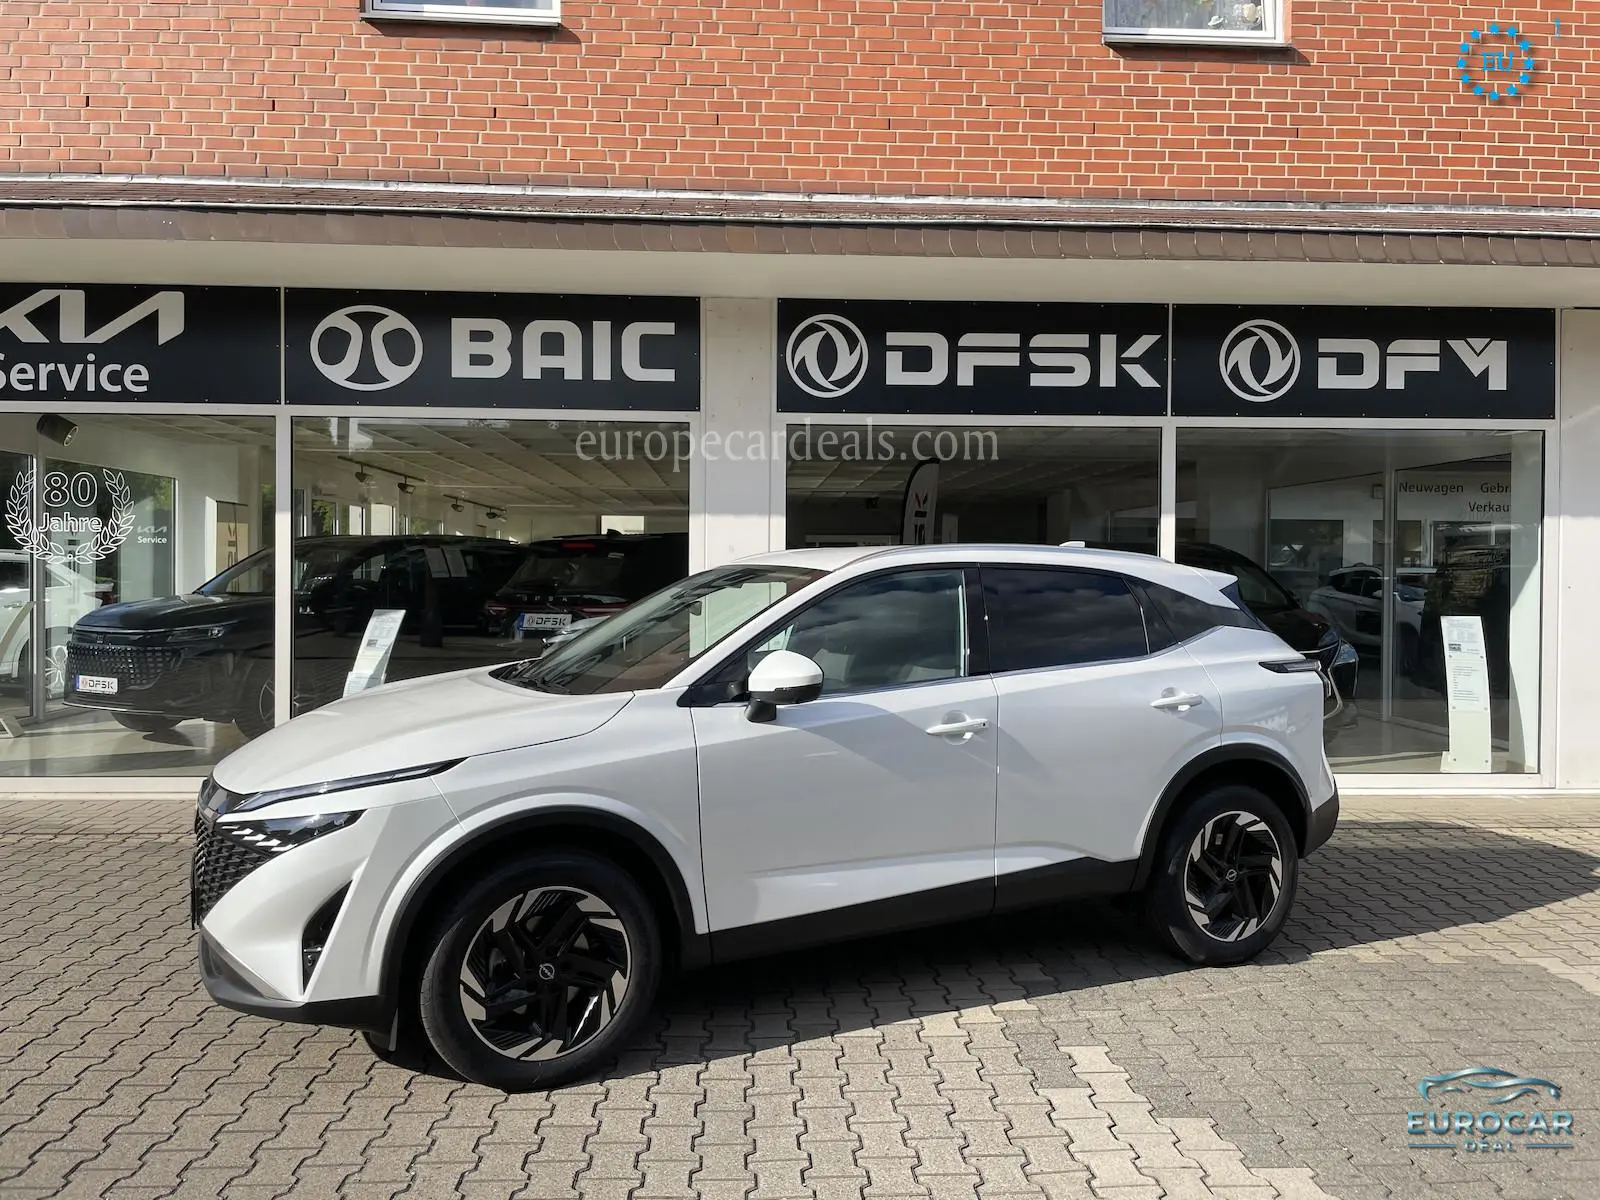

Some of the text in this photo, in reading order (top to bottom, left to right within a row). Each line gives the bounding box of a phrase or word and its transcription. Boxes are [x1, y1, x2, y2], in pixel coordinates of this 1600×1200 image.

[451, 317, 676, 382] BAIC
[886, 331, 1162, 388] DFSK
[1318, 337, 1507, 391] DFM
[43, 472, 97, 507] 80
[1399, 482, 1511, 495] Neuwagen Gebr
[1468, 501, 1511, 513] Verkau
[39, 512, 102, 532] Jahre
[137, 535, 167, 544] Service
[535, 617, 567, 626] DFSK
[88, 680, 113, 690] DFSK
